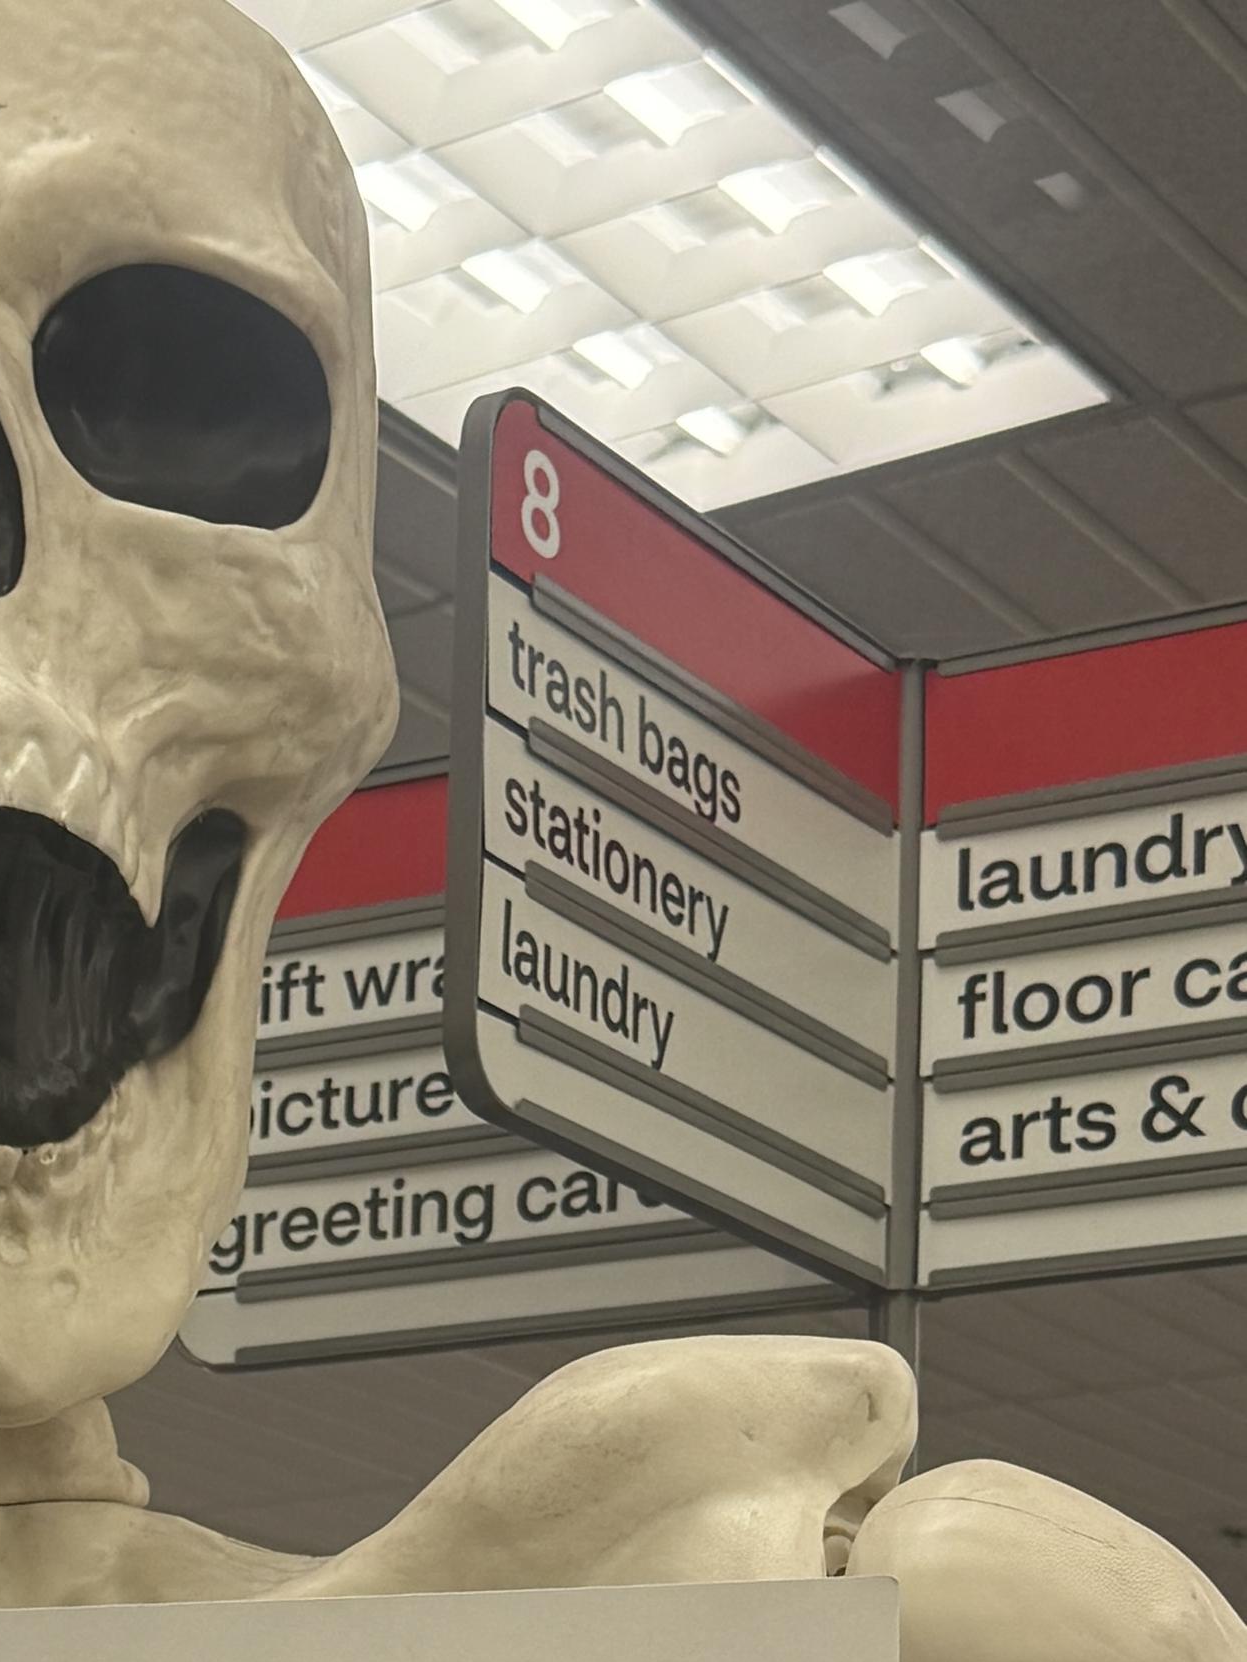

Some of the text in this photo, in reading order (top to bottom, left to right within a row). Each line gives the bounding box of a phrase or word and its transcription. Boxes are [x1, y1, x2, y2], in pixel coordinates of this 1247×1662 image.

[521, 449, 561, 559] 8
[508, 621, 741, 824] trash bags
[505, 777, 729, 962] stationery
[259, 960, 325, 1025] ift
[503, 898, 675, 1070] laundry
[957, 967, 1151, 1040] floor
[249, 1069, 455, 1139] icture
[959, 1096, 1117, 1166] arts
[1141, 1075, 1206, 1143] &
[209, 1168, 662, 1276] greeting car
